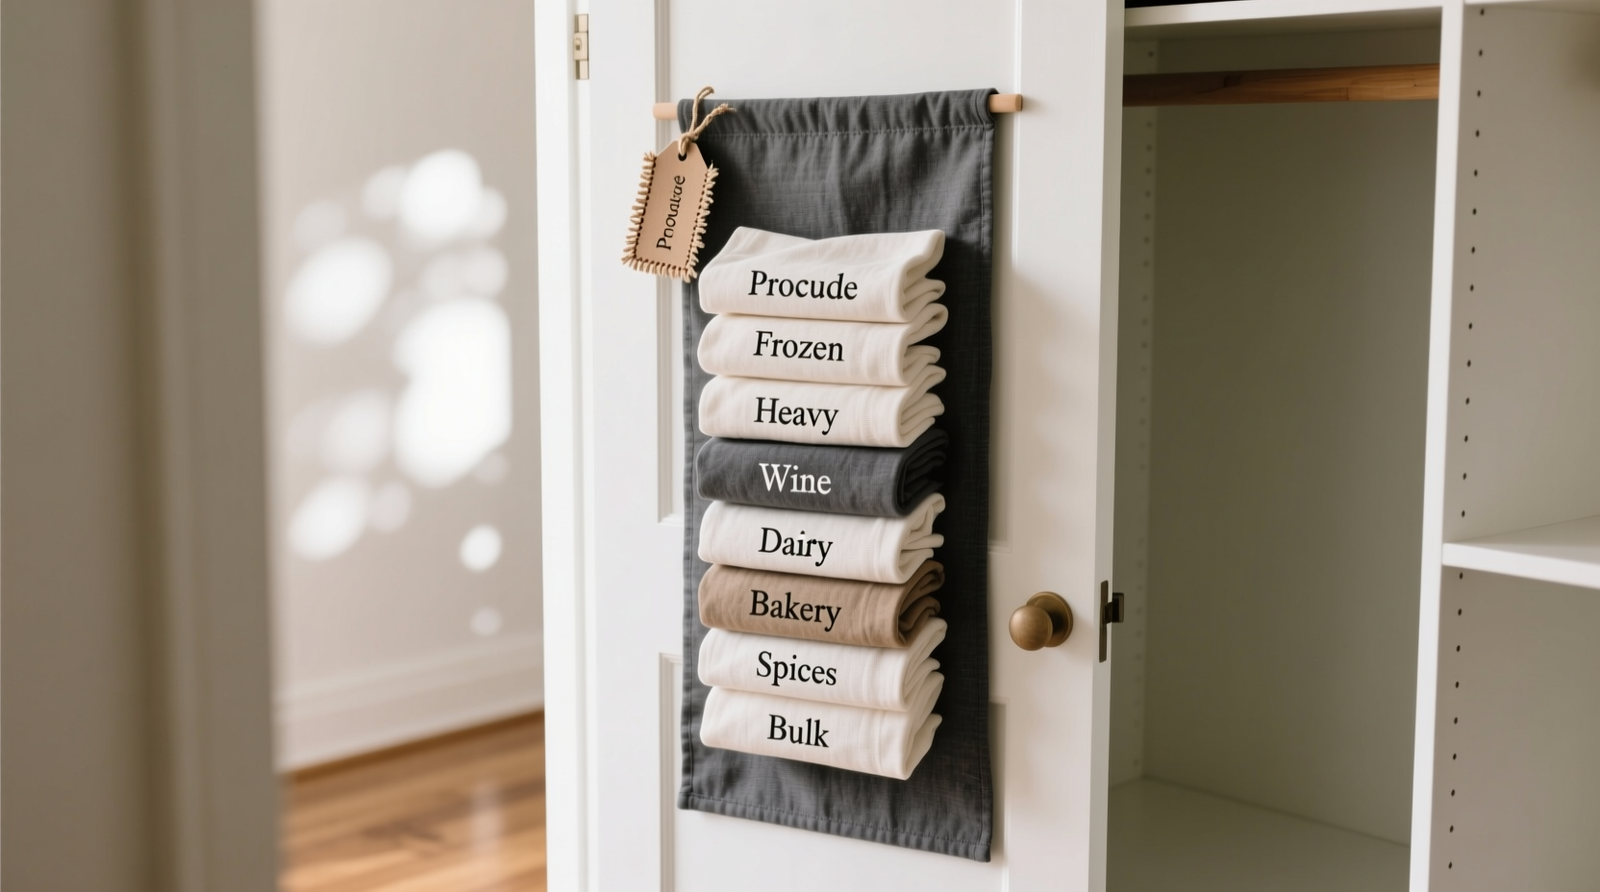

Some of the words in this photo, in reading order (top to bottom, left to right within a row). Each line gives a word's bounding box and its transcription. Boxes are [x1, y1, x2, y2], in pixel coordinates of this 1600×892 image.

[748, 270, 858, 301] Procude
[753, 331, 844, 362] Frozen
[753, 397, 840, 436] Heavy
[759, 462, 832, 495] Wine
[758, 527, 834, 567] Dairy
[749, 589, 842, 632] Bakery
[756, 651, 837, 687] Spices
[767, 714, 830, 748] Bulk
